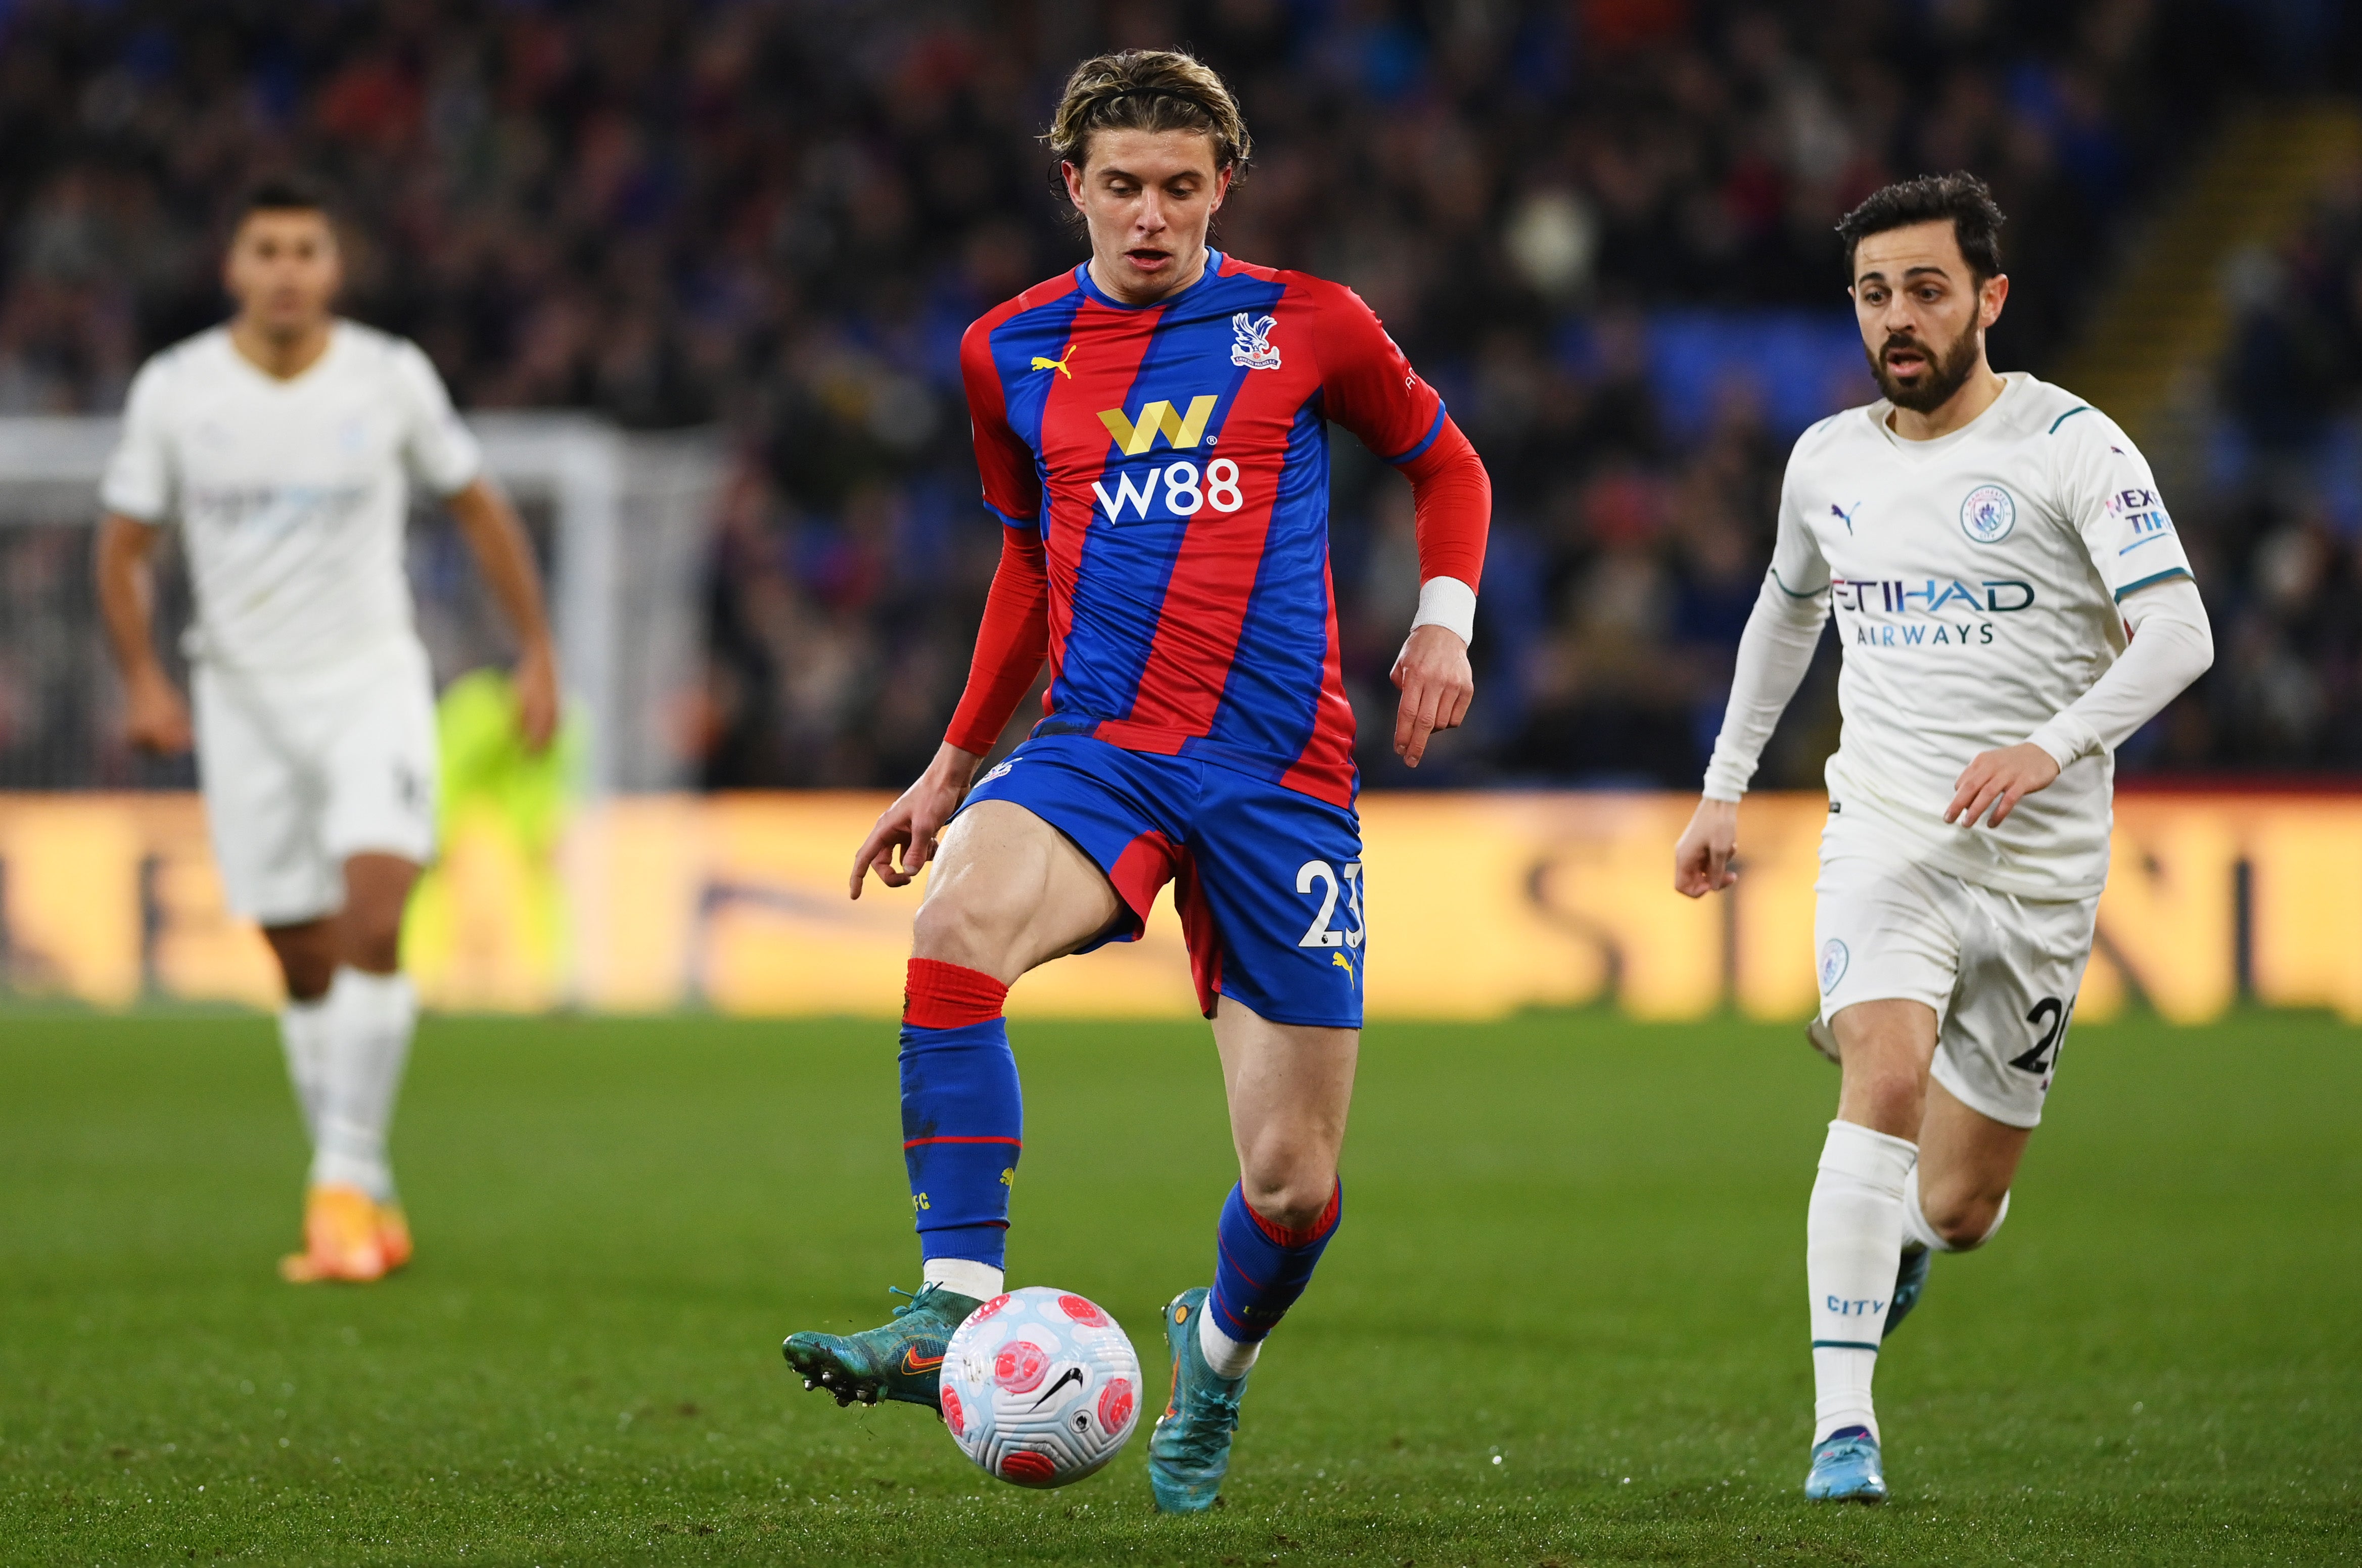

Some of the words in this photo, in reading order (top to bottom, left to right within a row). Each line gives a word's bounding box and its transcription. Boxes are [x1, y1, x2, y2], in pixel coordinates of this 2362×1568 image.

[1236, 357, 1254, 365] CRYSTAL
[1091, 458, 1243, 526] W88
[1832, 580, 2035, 612] ETIHAD
[1857, 623, 1994, 646] AIRWAYS
[1296, 860, 1364, 948] 23
[1827, 1294, 1885, 1316] CITY
